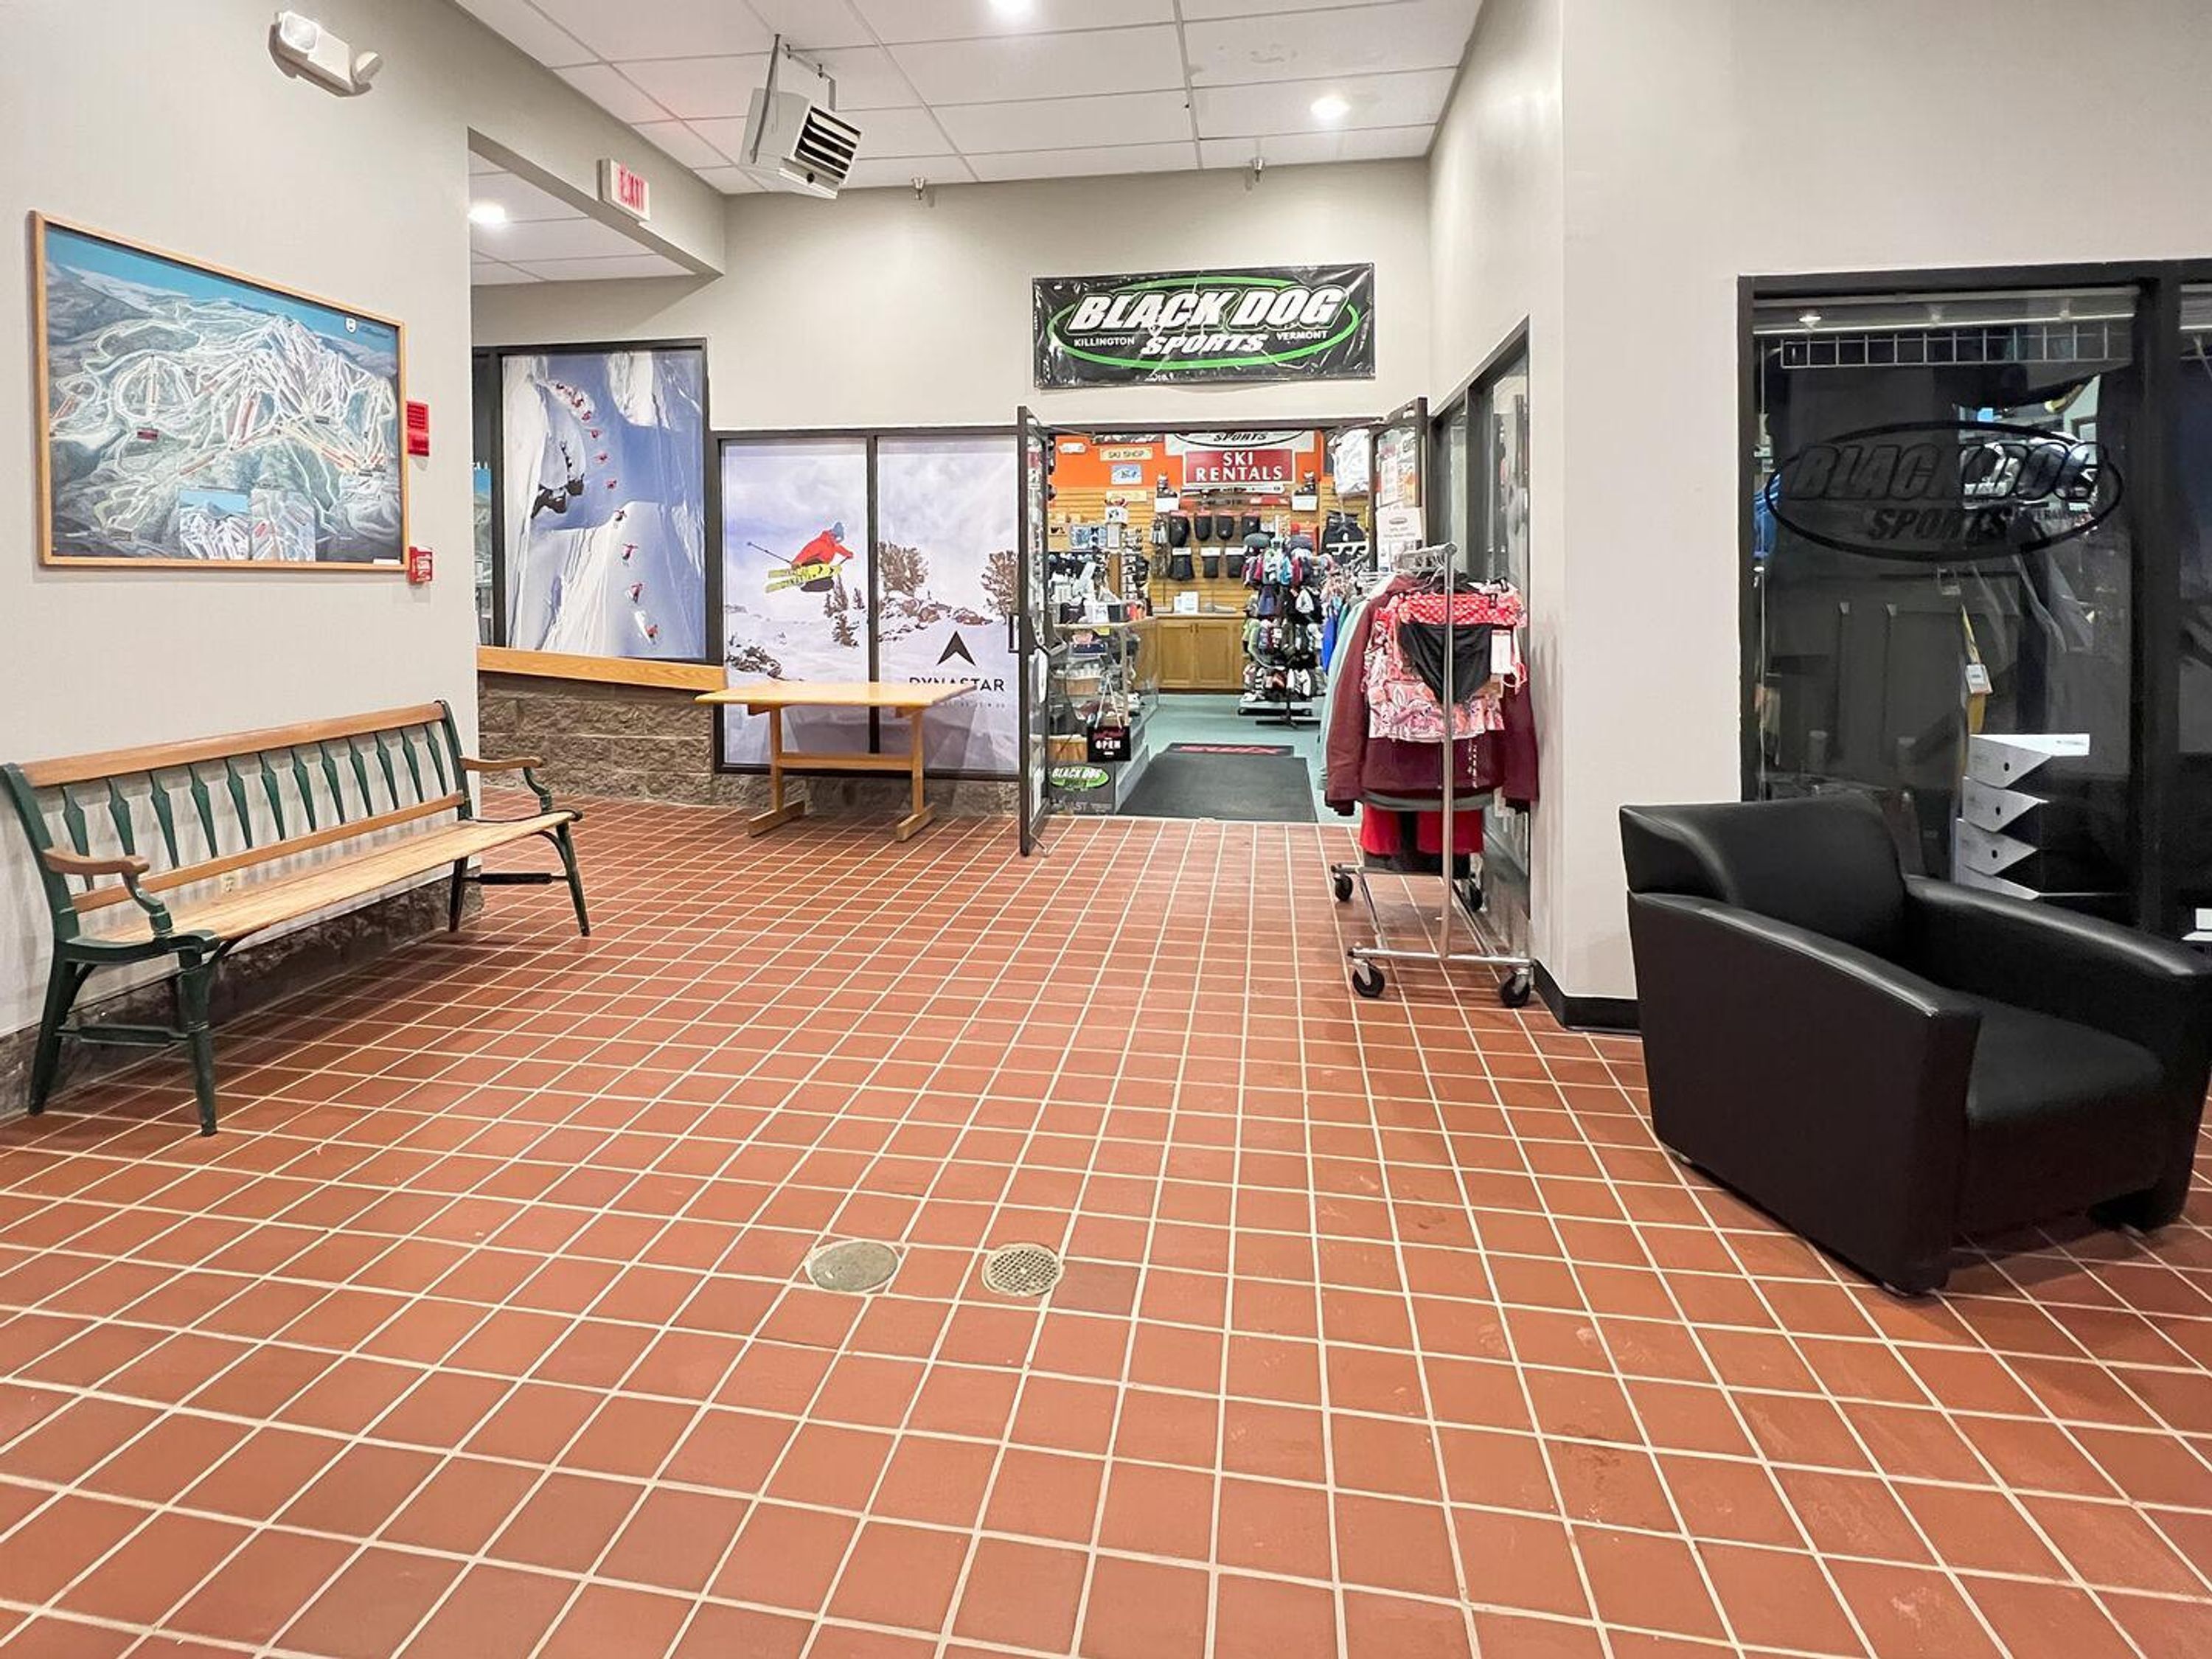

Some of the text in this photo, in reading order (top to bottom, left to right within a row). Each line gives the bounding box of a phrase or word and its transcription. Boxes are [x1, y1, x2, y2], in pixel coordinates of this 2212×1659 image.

[618, 166, 645, 212] EXIT
[1068, 288, 1344, 330] BLACK DOG
[1074, 337, 1135, 347] KILLINGTON
[1276, 330, 1328, 341] VERMONT
[1141, 333, 1270, 355] SPORTS
[1213, 432, 1267, 442] SPORTS
[1222, 451, 1253, 467] SKI
[1195, 465, 1284, 481] RENTALS
[1787, 442, 1983, 501] BLACK
[1095, 740, 1121, 750] OPEN
